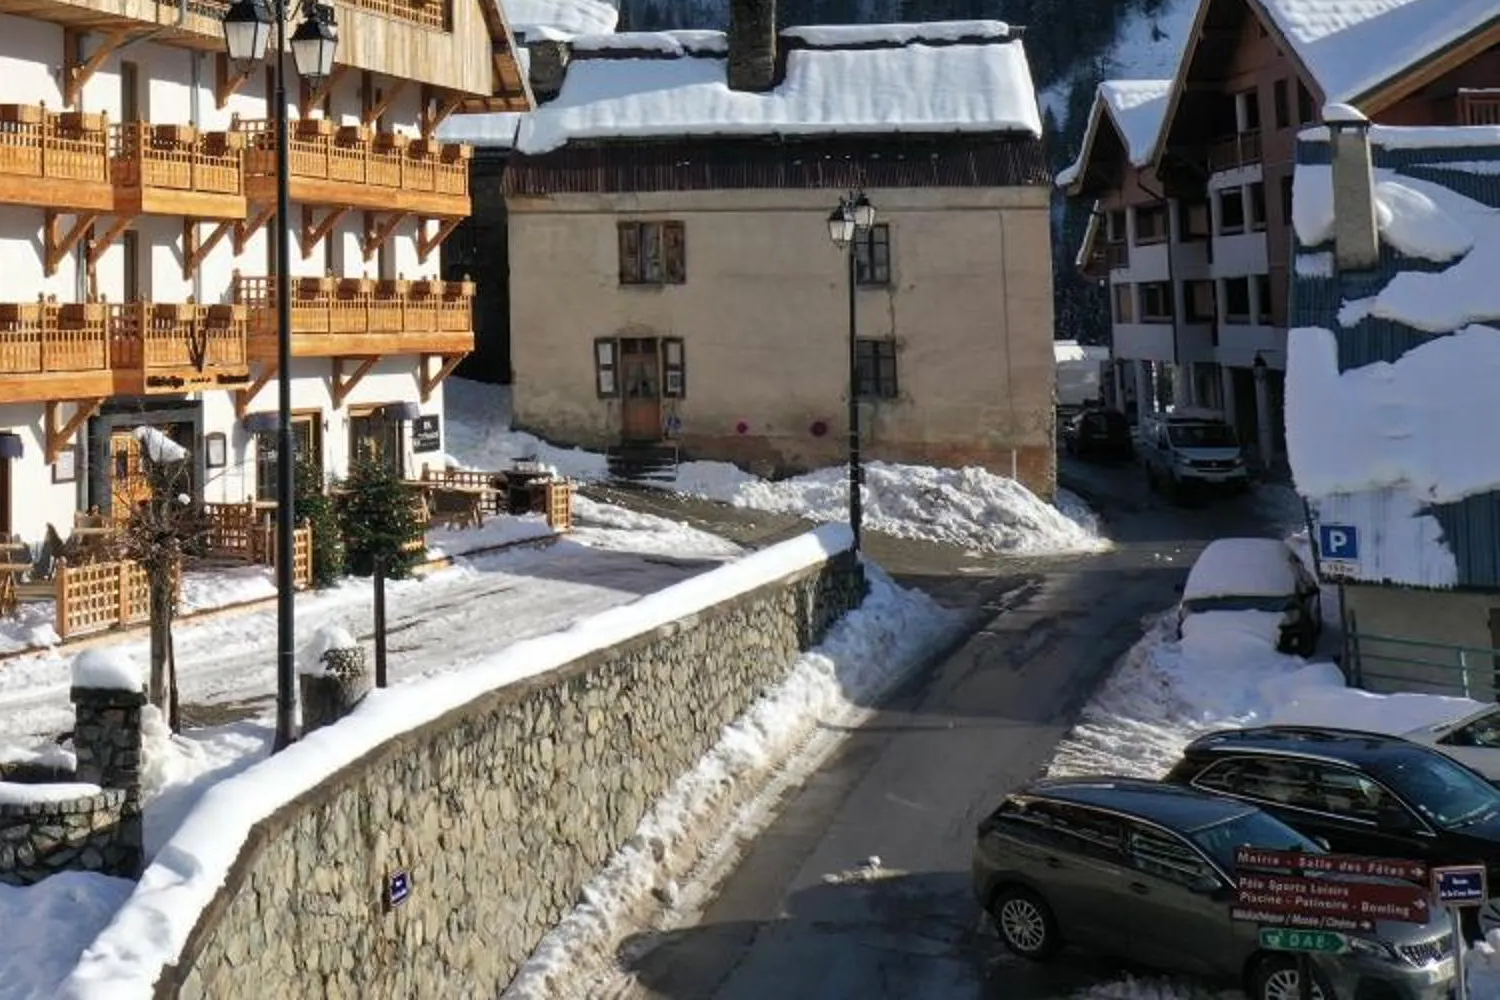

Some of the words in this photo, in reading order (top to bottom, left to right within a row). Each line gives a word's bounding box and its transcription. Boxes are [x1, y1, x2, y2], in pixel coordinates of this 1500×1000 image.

[1329, 529, 1347, 553] P
[1299, 857, 1332, 870] Salle
[1339, 861, 1361, 873] des
[1239, 891, 1281, 905] Piscine
[1295, 896, 1348, 910] Patinoire
[1361, 901, 1410, 917] Bowling
